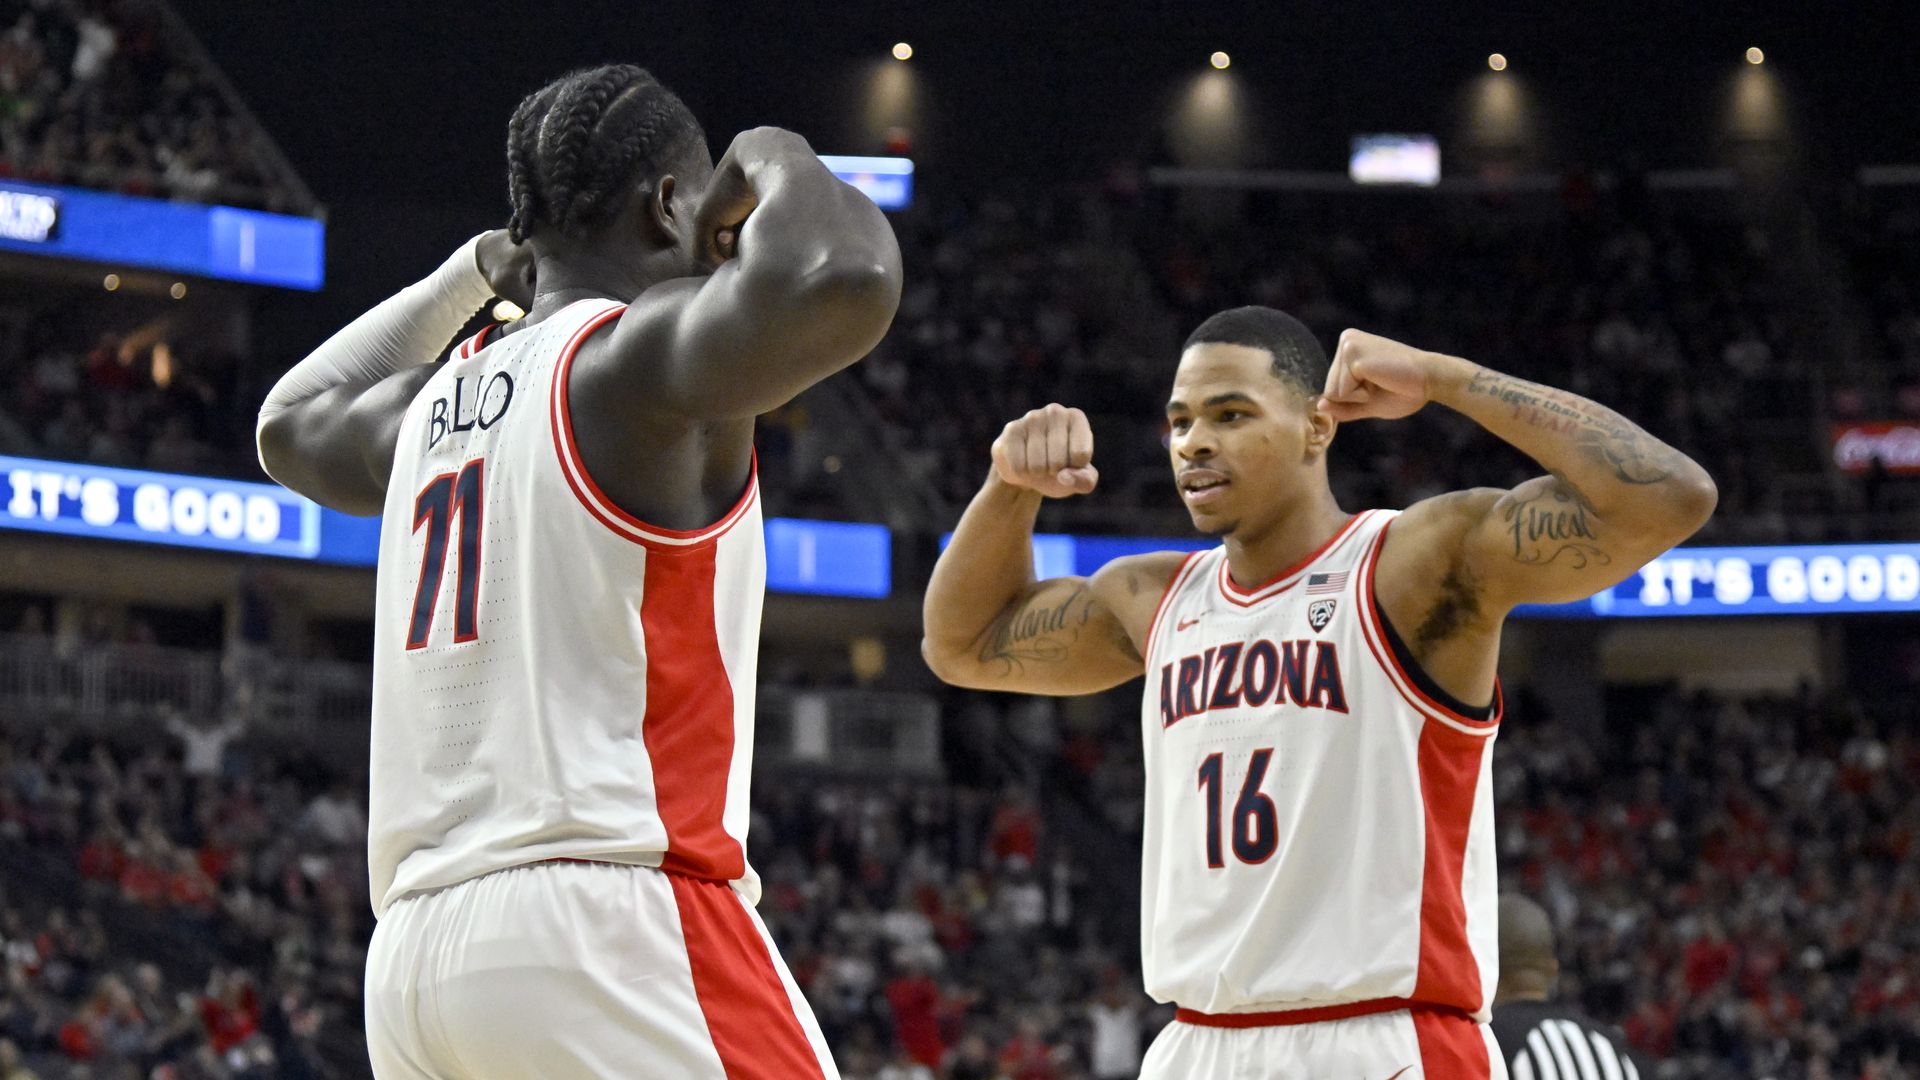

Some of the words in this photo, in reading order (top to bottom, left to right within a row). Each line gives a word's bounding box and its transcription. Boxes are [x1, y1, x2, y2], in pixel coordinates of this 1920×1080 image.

[428, 371, 514, 451] BLO
[1544, 400, 1581, 419] than
[9, 469, 120, 526] IT'S
[133, 482, 281, 543] GOOD
[405, 457, 485, 651] 11
[1638, 558, 1753, 606] IT'S
[1767, 555, 1920, 604] GOOD
[1312, 612, 1326, 626] 12
[1160, 639, 1349, 730] ARIZONA
[1198, 747, 1279, 869] 16
